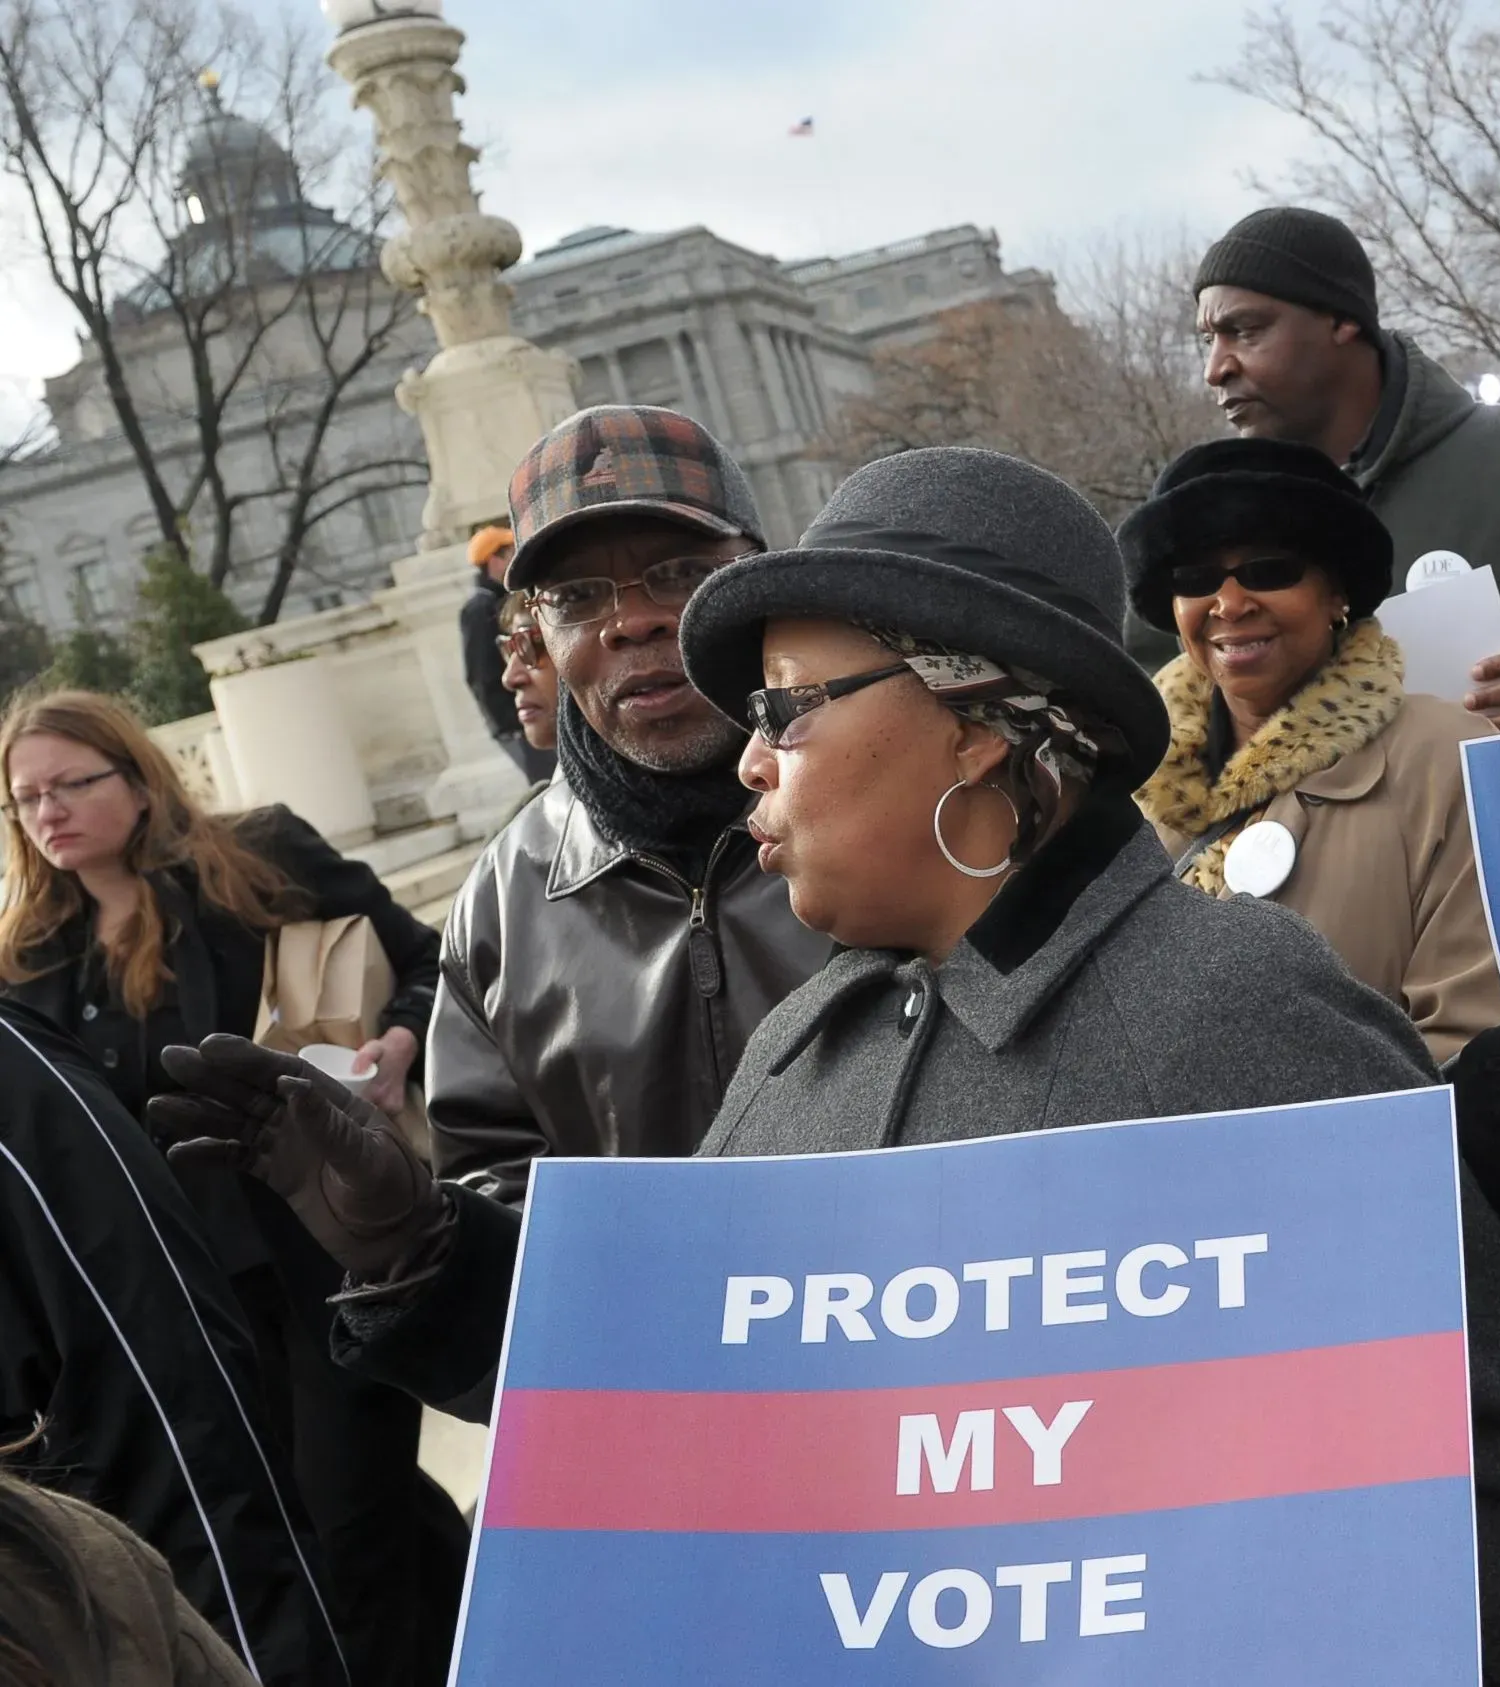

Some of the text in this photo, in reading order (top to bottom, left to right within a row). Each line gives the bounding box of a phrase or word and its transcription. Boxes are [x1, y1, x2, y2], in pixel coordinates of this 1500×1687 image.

[721, 1233, 1268, 1344] PROTECT
[896, 1399, 1094, 1496] MY
[819, 1553, 1147, 1649] VOTE
